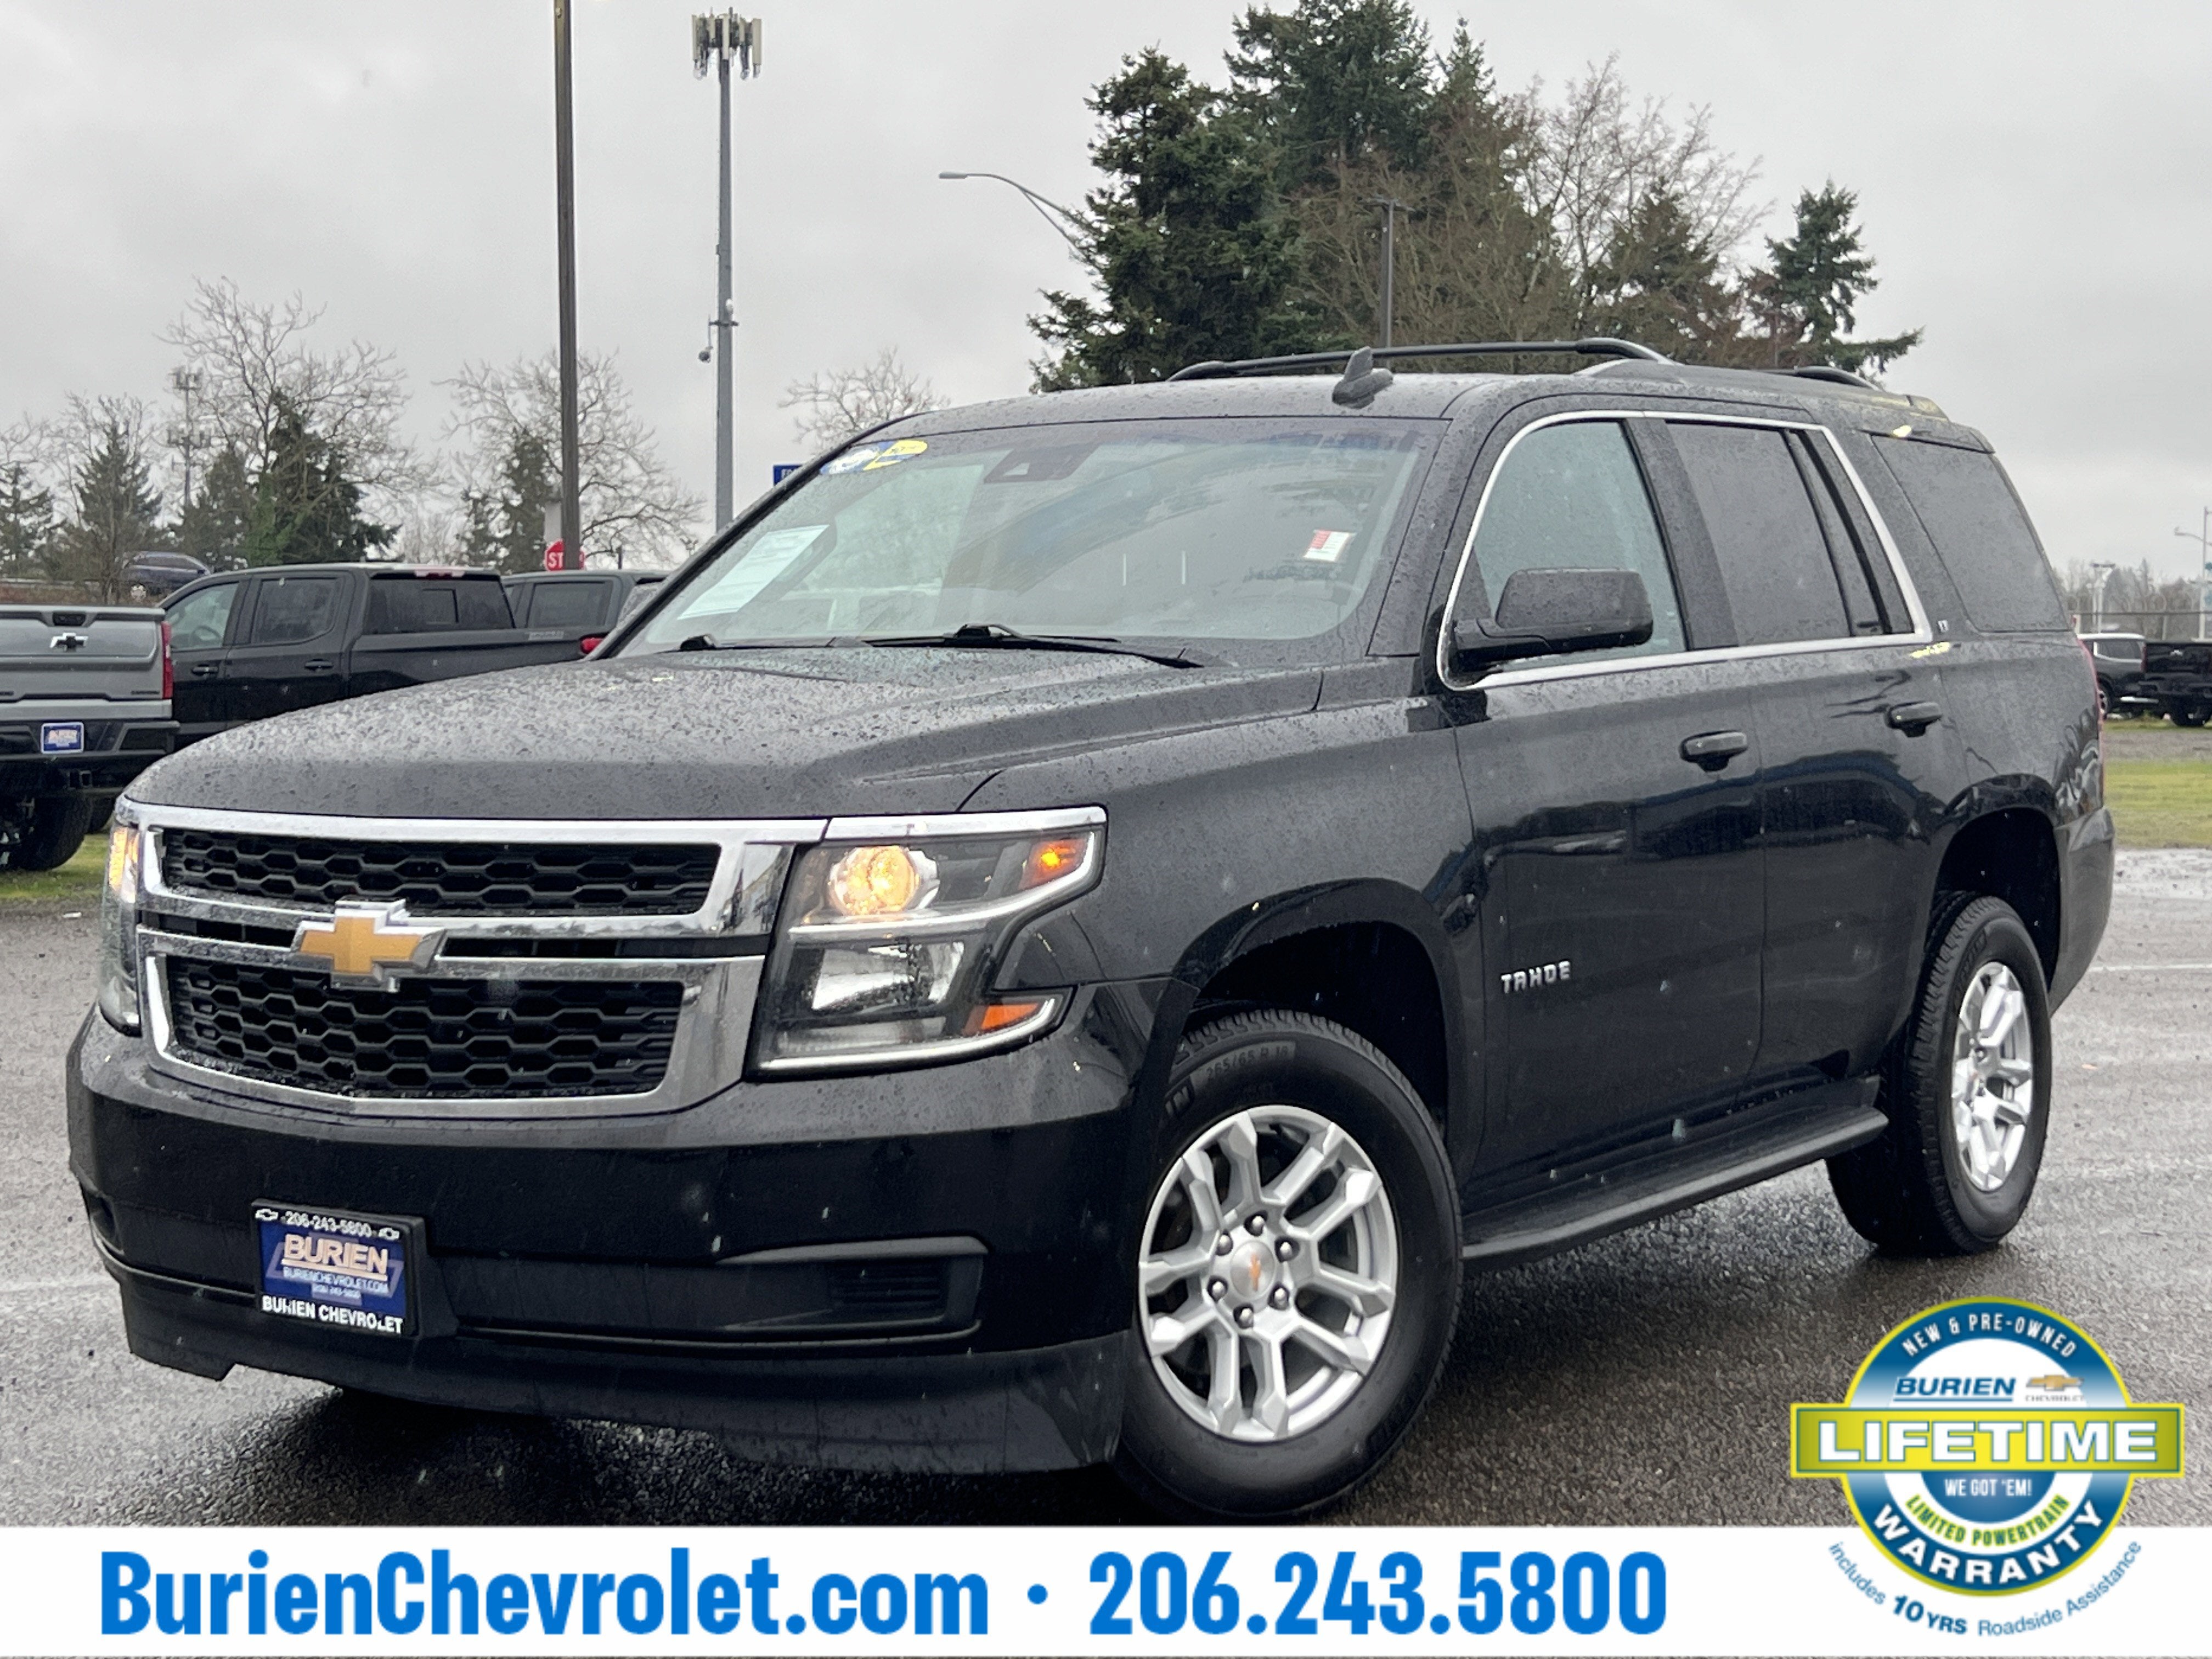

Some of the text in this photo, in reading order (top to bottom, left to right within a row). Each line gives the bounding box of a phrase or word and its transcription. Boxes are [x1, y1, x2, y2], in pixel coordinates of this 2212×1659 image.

[1501, 961, 1571, 994] TAHOE
[285, 1211, 371, 1237] 206-243-5800
[284, 1234, 388, 1274] BURIEN
[262, 1295, 403, 1334] BURIEN CHEVROLET
